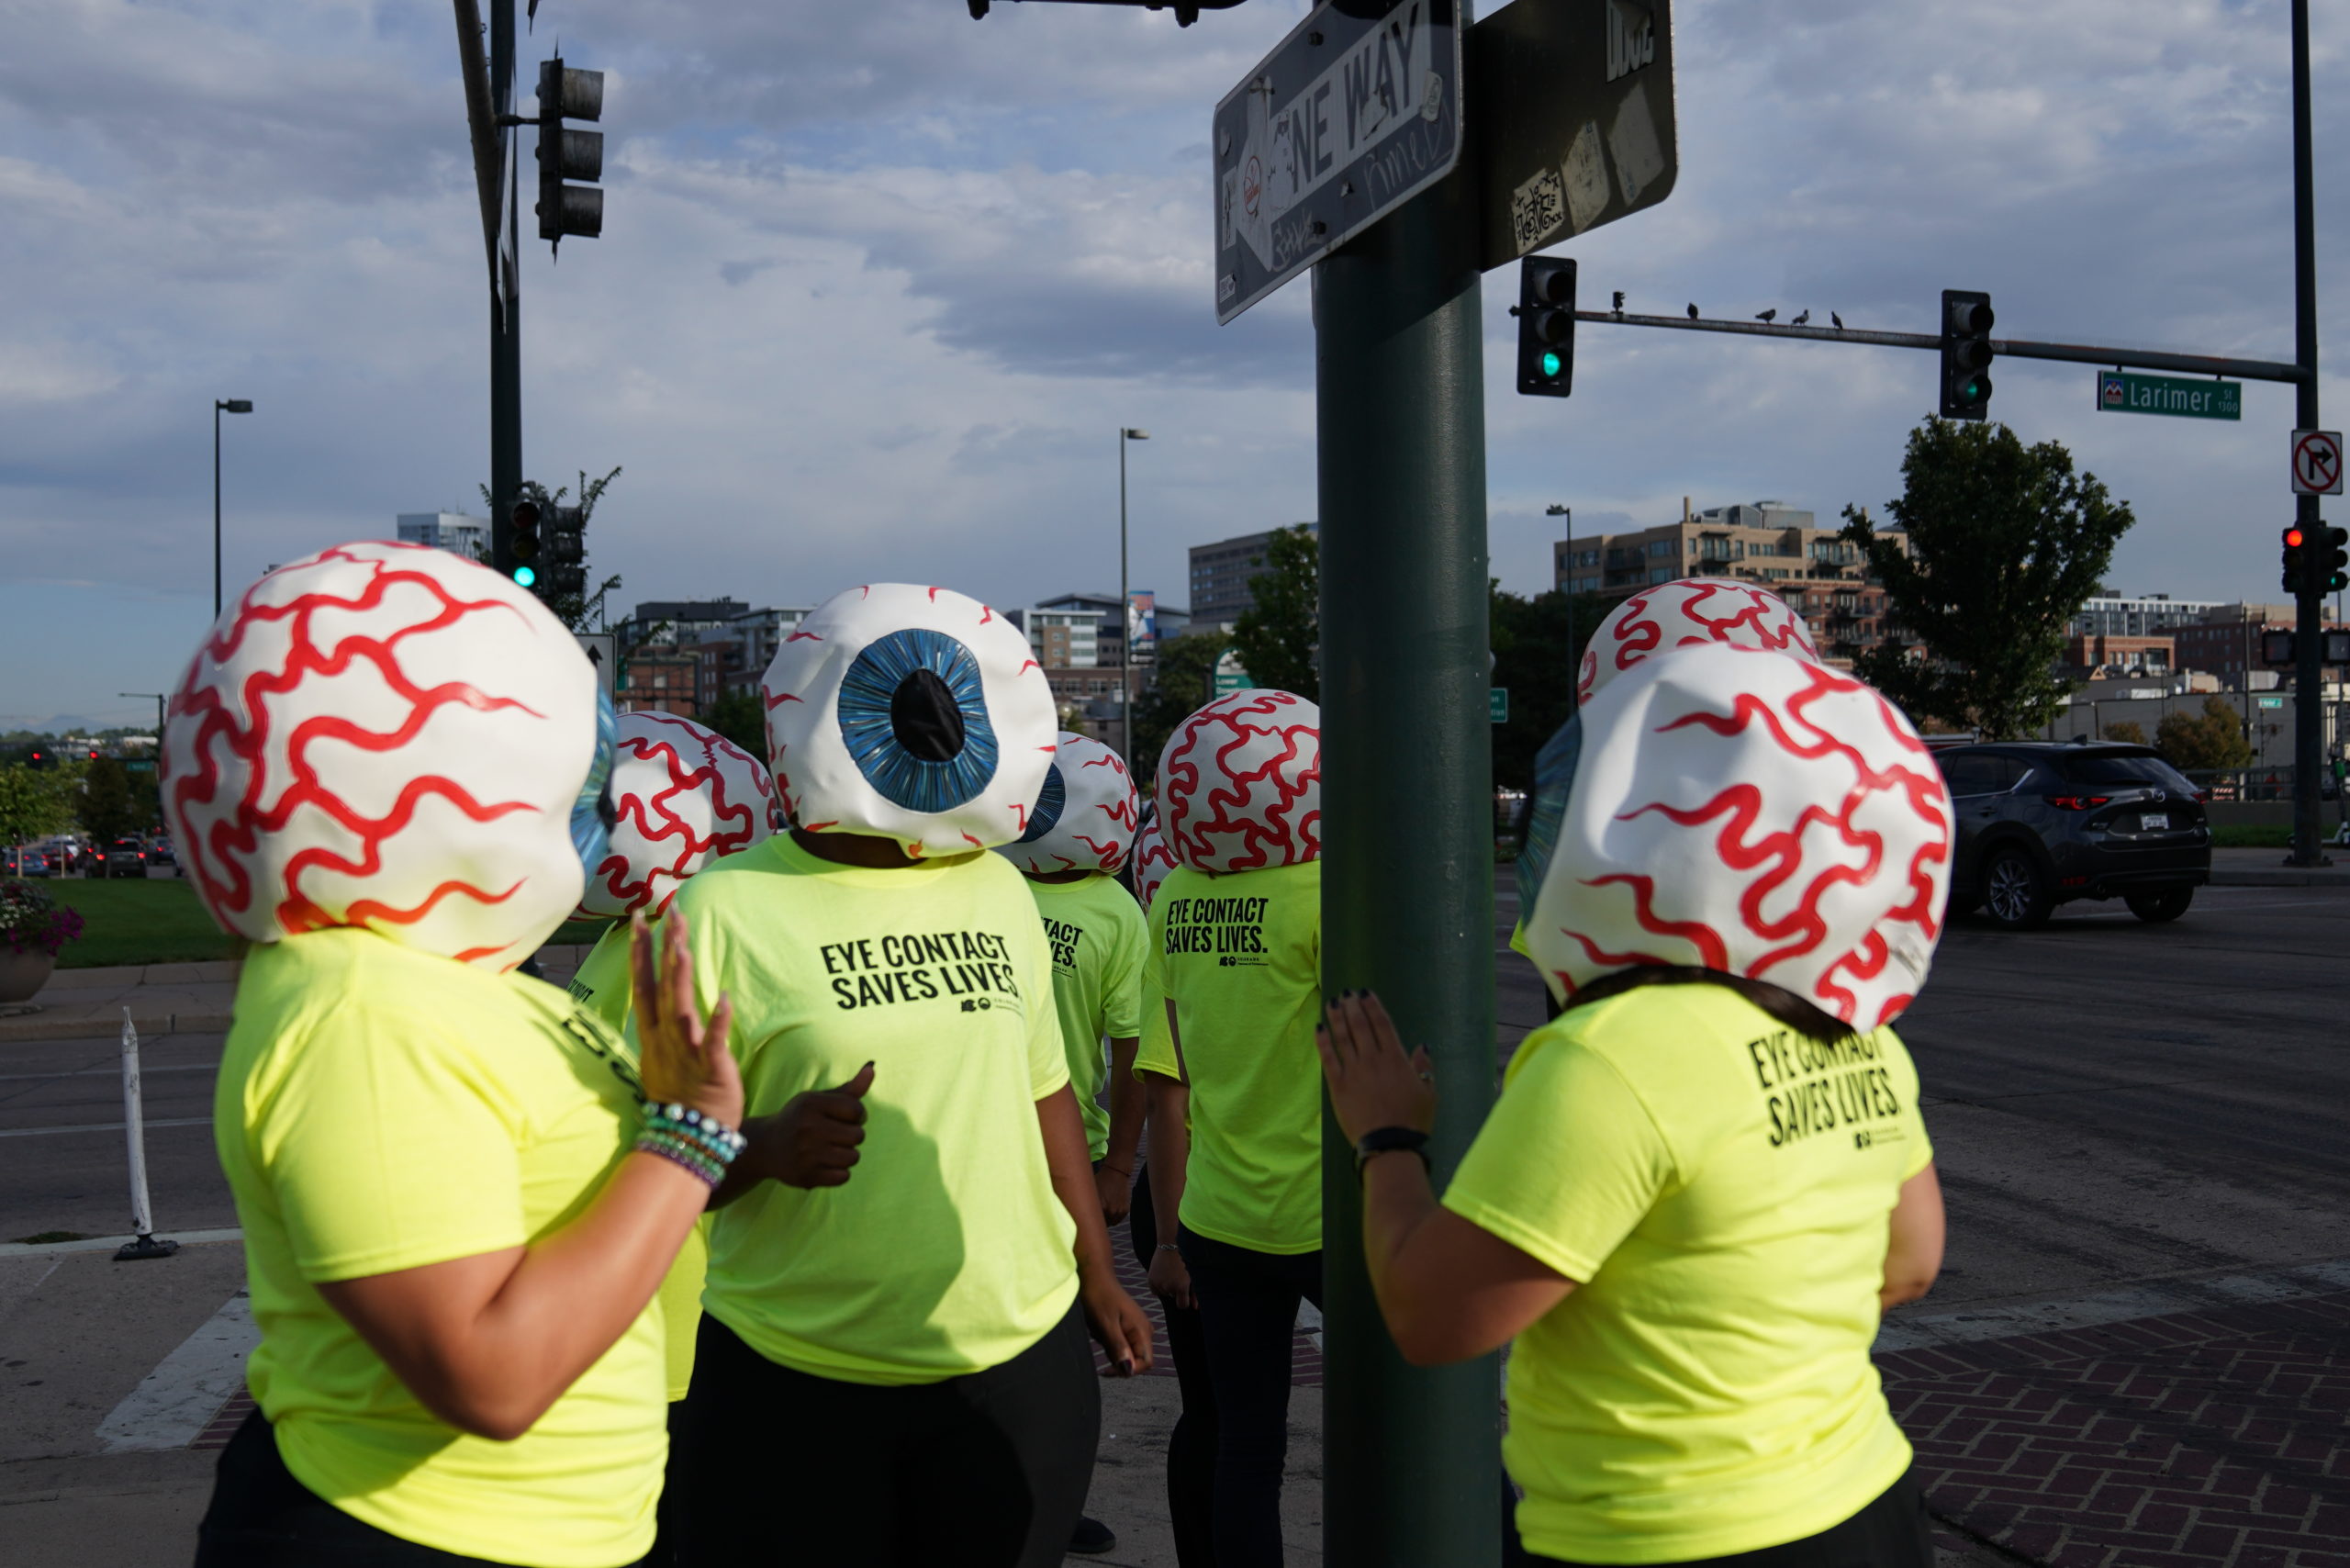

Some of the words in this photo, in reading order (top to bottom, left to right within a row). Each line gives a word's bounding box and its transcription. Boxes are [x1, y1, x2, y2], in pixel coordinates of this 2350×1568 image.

[1289, 81, 1333, 196] NE
[1344, 2, 1419, 151] WAY
[2130, 381, 2211, 411] Larimer
[2223, 388, 2233, 400] St
[1167, 898, 1191, 925] EYE
[1193, 897, 1269, 924] CONTACT
[1041, 917, 1083, 946] TACT
[1166, 925, 1212, 955] SAVES
[1217, 925, 1269, 953] LIVES.
[820, 938, 878, 974] EYE
[881, 931, 1011, 968] CONTACT
[832, 969, 938, 1010] SAVES
[1748, 1030, 1796, 1089] EYE
[1768, 1079, 1836, 1147] SAVES
